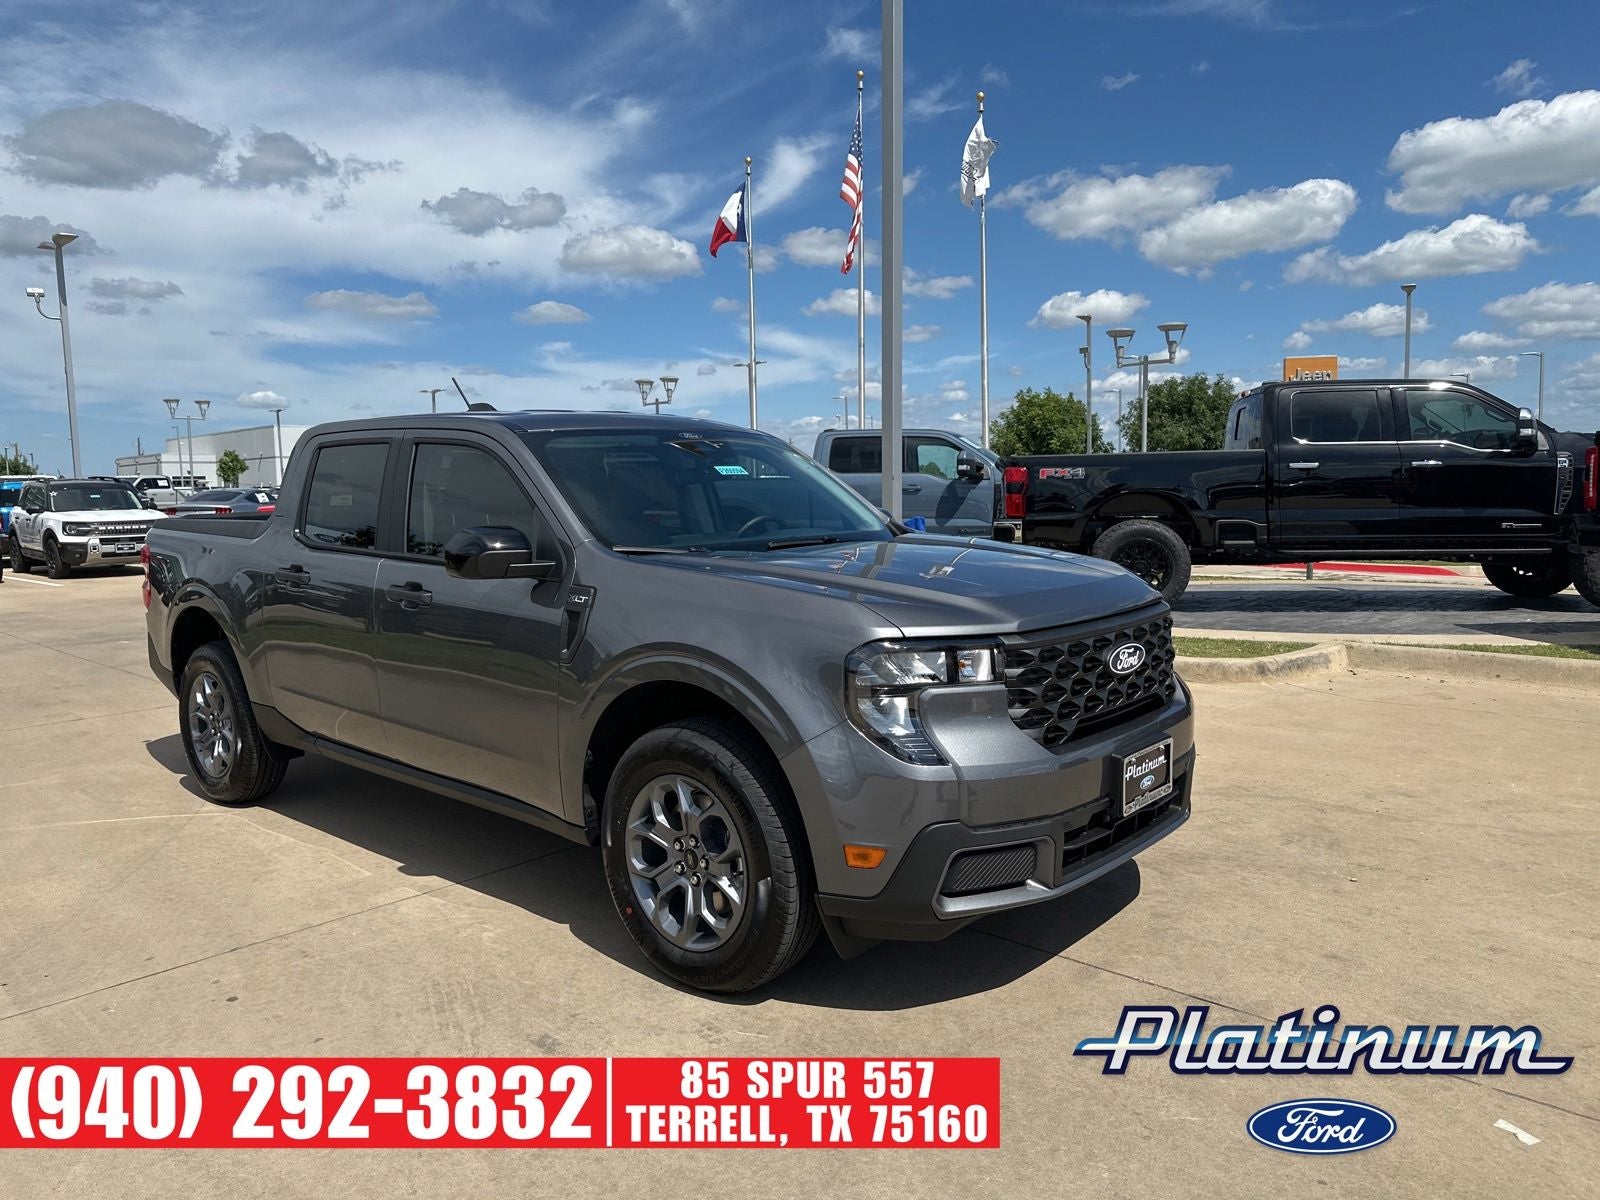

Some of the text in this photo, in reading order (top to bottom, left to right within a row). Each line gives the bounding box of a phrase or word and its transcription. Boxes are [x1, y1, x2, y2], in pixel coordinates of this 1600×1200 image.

[1039, 467, 1085, 479] FX4
[570, 594, 588, 602] XLT
[1117, 647, 1140, 670] Ford
[1125, 755, 1167, 781] Platinum
